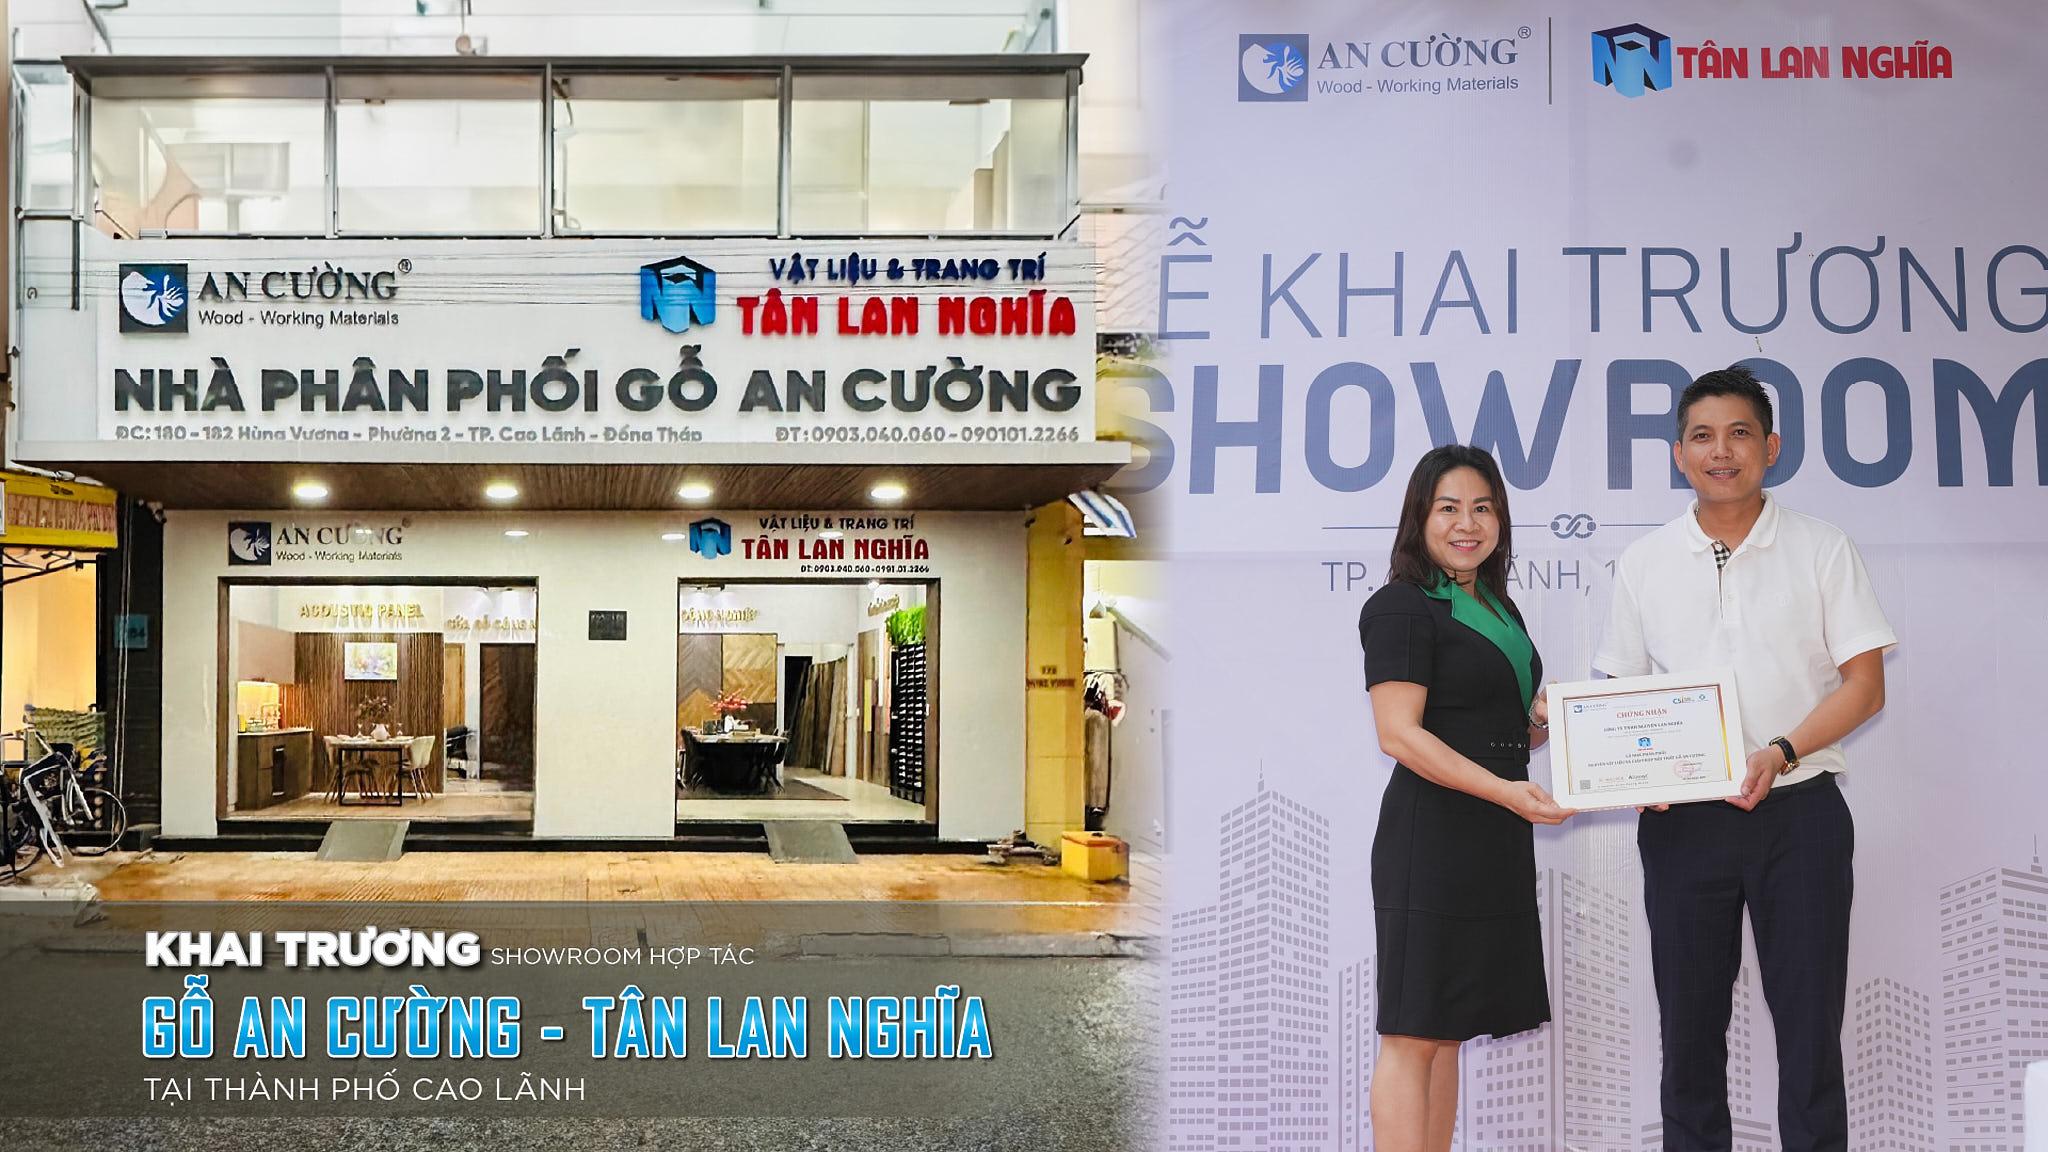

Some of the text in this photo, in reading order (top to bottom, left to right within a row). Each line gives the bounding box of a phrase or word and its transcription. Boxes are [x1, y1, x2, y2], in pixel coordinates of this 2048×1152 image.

[1317, 32, 1519, 69] AN CƯỜNG
[1677, 40, 1952, 79] TÂN LAN NGHĨA
[1317, 79, 1363, 94] Wood
[1377, 77, 1441, 95] Working
[1447, 75, 1519, 92] Materials
[198, 262, 398, 301] AN CƯỜNG
[769, 252, 819, 284] VẬT
[886, 259, 904, 280] &
[912, 258, 1000, 280] TRANG
[1009, 252, 1046, 280] TRÍ
[1260, 248, 1517, 339] KHAI
[1563, 232, 2048, 335] TRƯƠNG
[199, 310, 244, 326] Wood
[260, 310, 325, 329] Working
[330, 309, 400, 327] Materials
[737, 288, 1075, 336] TÂN LAN NGHĨA
[114, 345, 1082, 413] NHÀ PHÂN PHỐI GỖ AN CƯỜNG
[441, 426, 451, 441] 2
[468, 426, 494, 441] TP.
[500, 426, 537, 441] Cao
[543, 426, 585, 441] Lãnh
[276, 527, 310, 545] AN
[839, 517, 888, 529] TRANG
[893, 514, 915, 529] TRÍ
[275, 551, 305, 561] Wood
[315, 551, 354, 563] Working
[358, 550, 403, 561] Materials
[741, 534, 929, 560] TÂN LAN NGHĨA
[1321, 561, 1374, 592] TP.
[1507, 554, 1590, 597] ÃNH,
